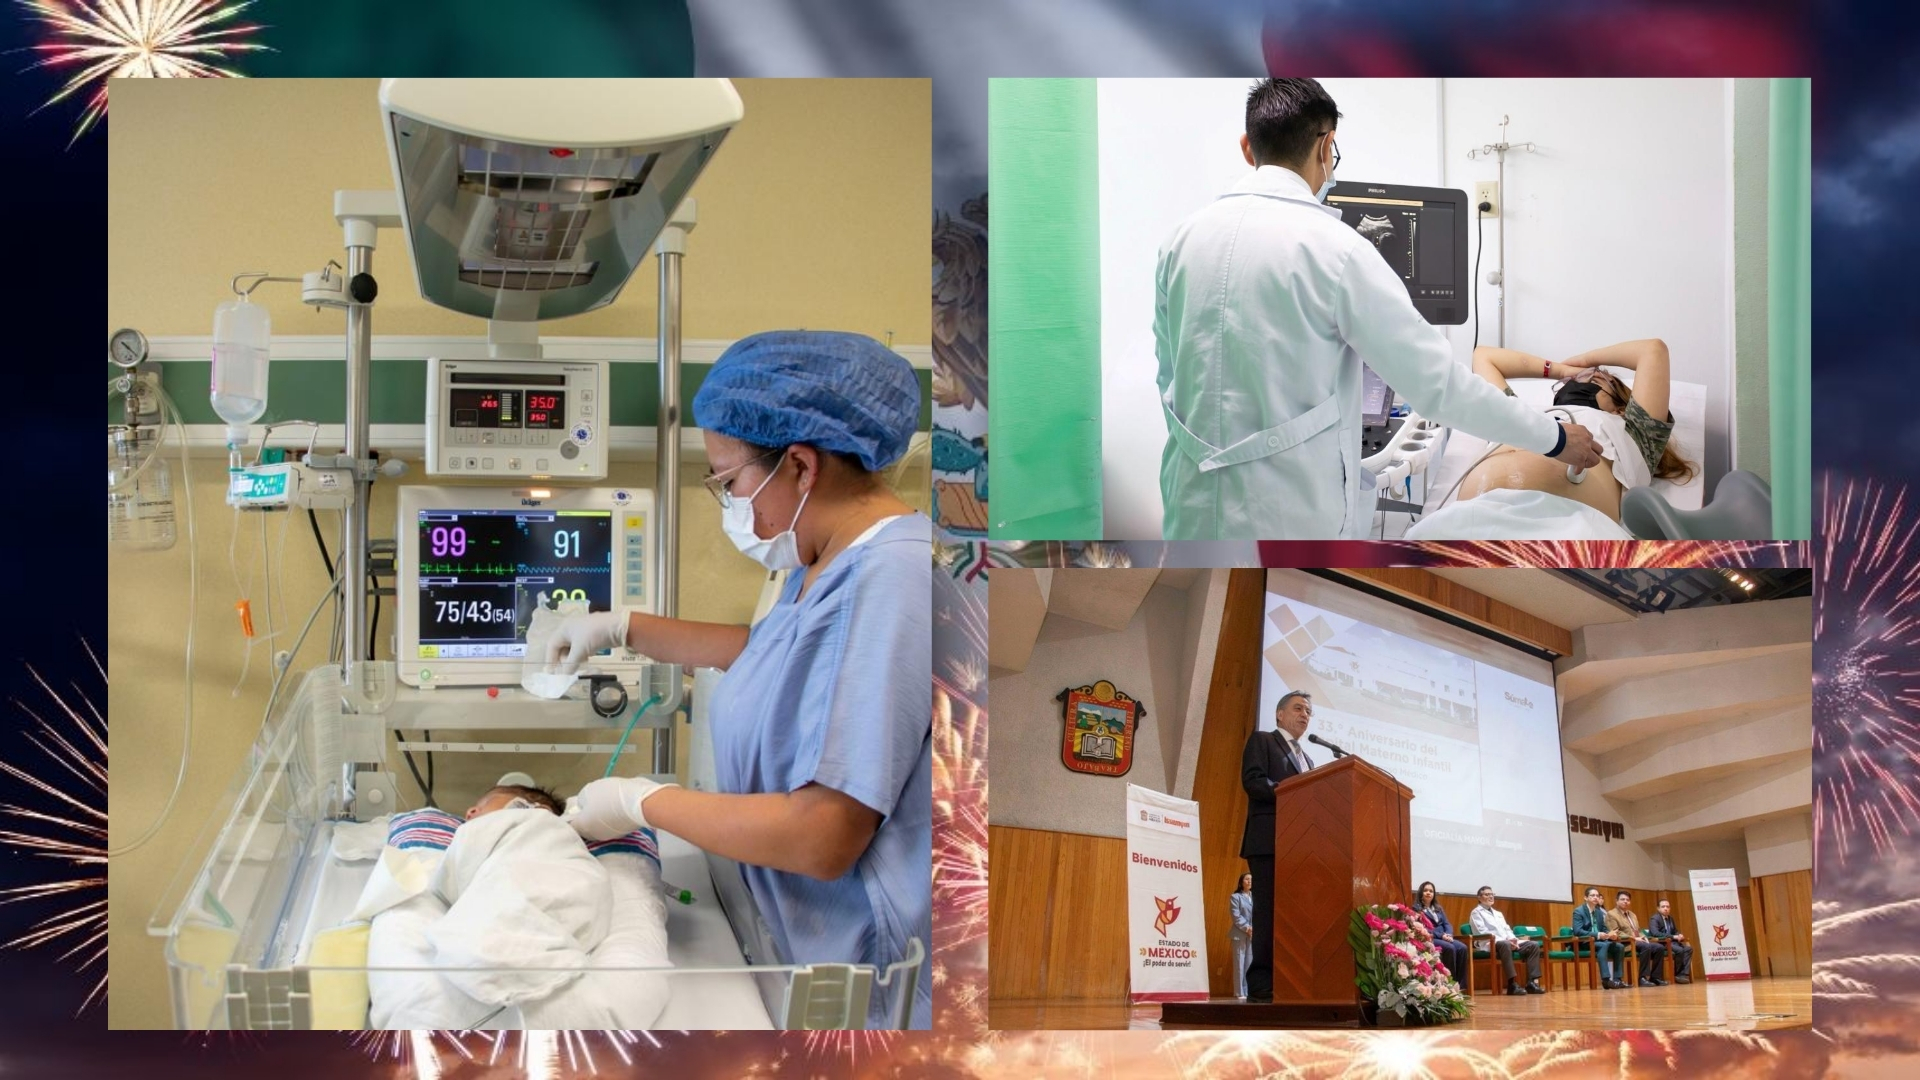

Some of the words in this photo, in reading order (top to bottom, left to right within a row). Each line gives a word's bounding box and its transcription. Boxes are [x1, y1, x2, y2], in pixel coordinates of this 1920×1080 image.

[432, 526, 467, 557] 99
[553, 530, 580, 558] 91
[1347, 726, 1417, 751] Aniversario
[1420, 743, 1438, 756] del
[1359, 742, 1410, 764] Materno
[1413, 756, 1452, 773] Infantil
[1132, 852, 1198, 873] Bienvenidos
